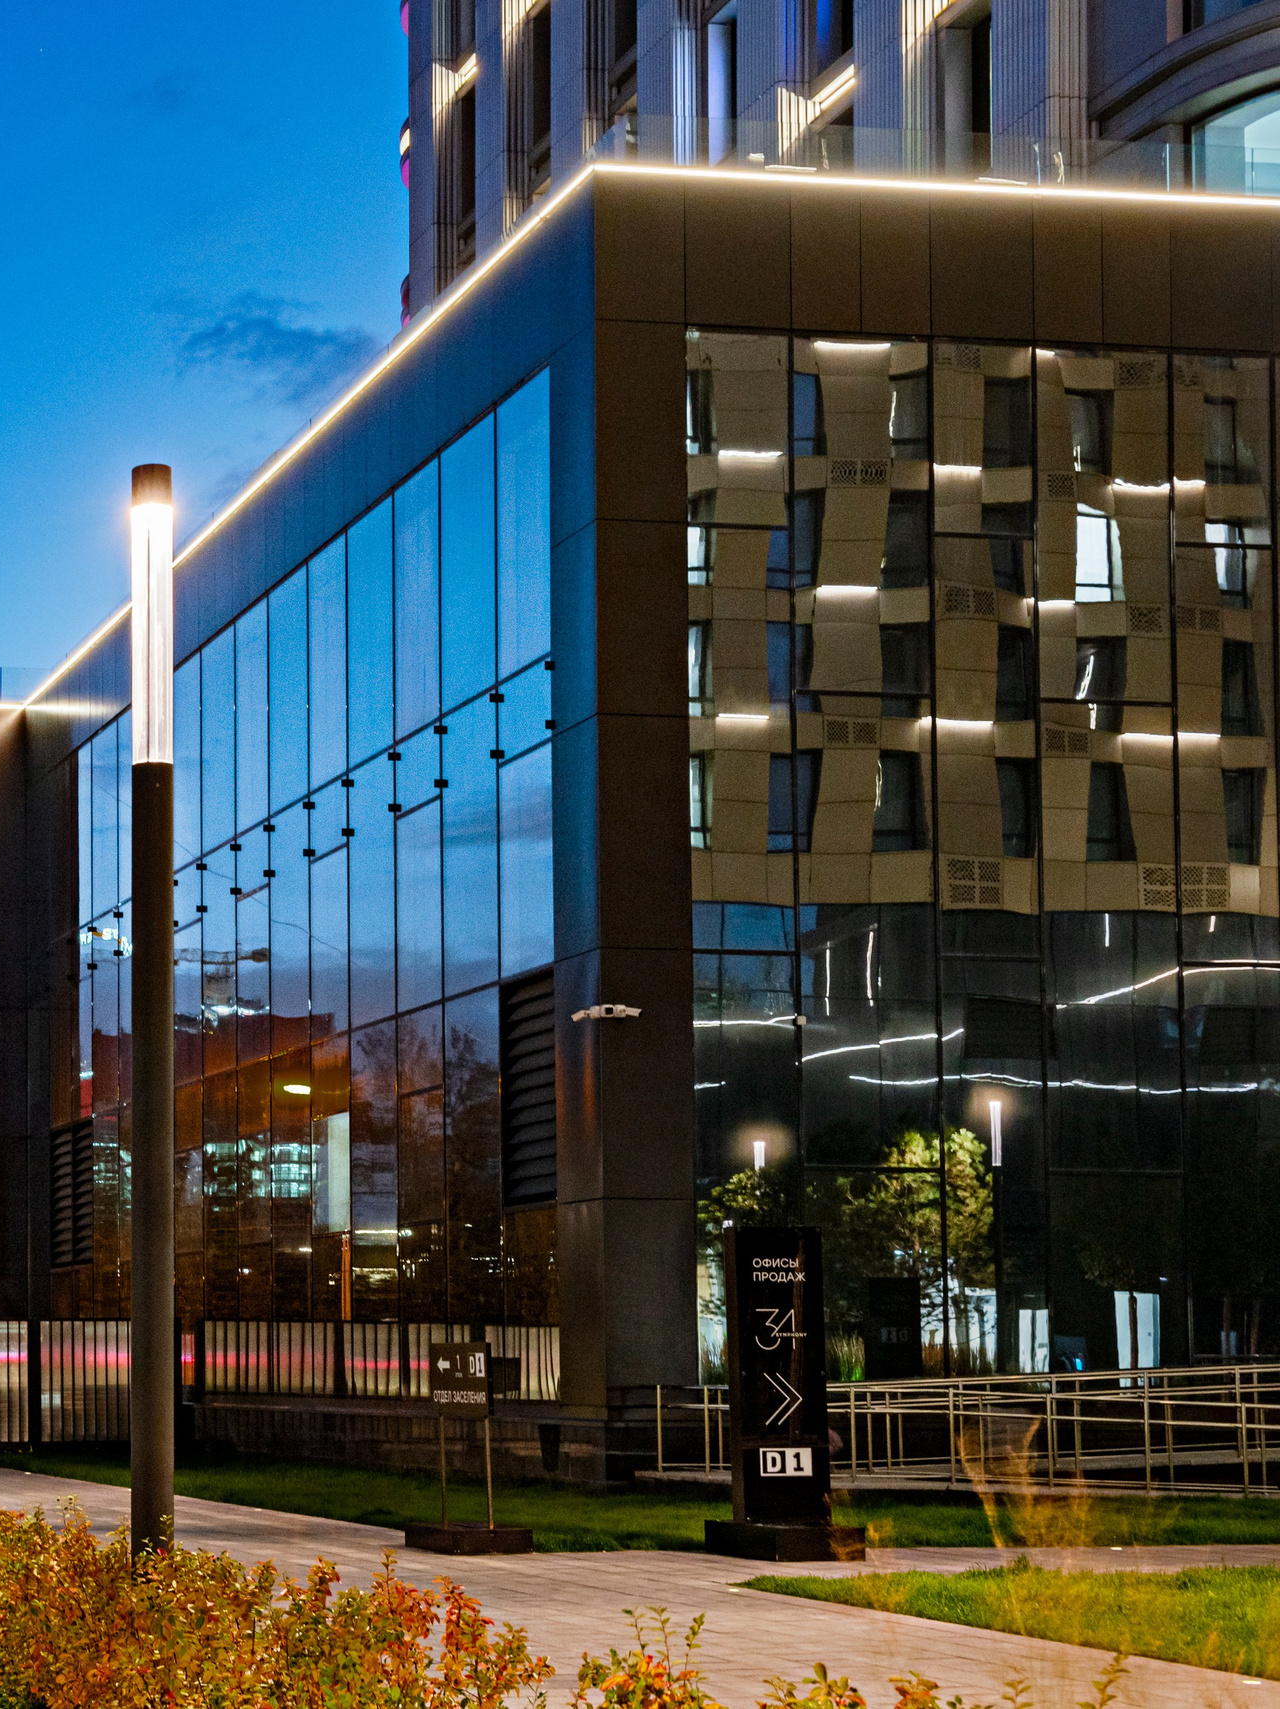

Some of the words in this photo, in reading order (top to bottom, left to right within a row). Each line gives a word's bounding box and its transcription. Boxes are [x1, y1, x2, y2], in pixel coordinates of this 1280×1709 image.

[752, 1258, 799, 1268] ОФИСЫ
[753, 1271, 806, 1283] ПРОДАЖ
[433, 1390, 452, 1404] ОТДЕЛ
[453, 1391, 486, 1404] ЗАСЕЛЕНИЯ
